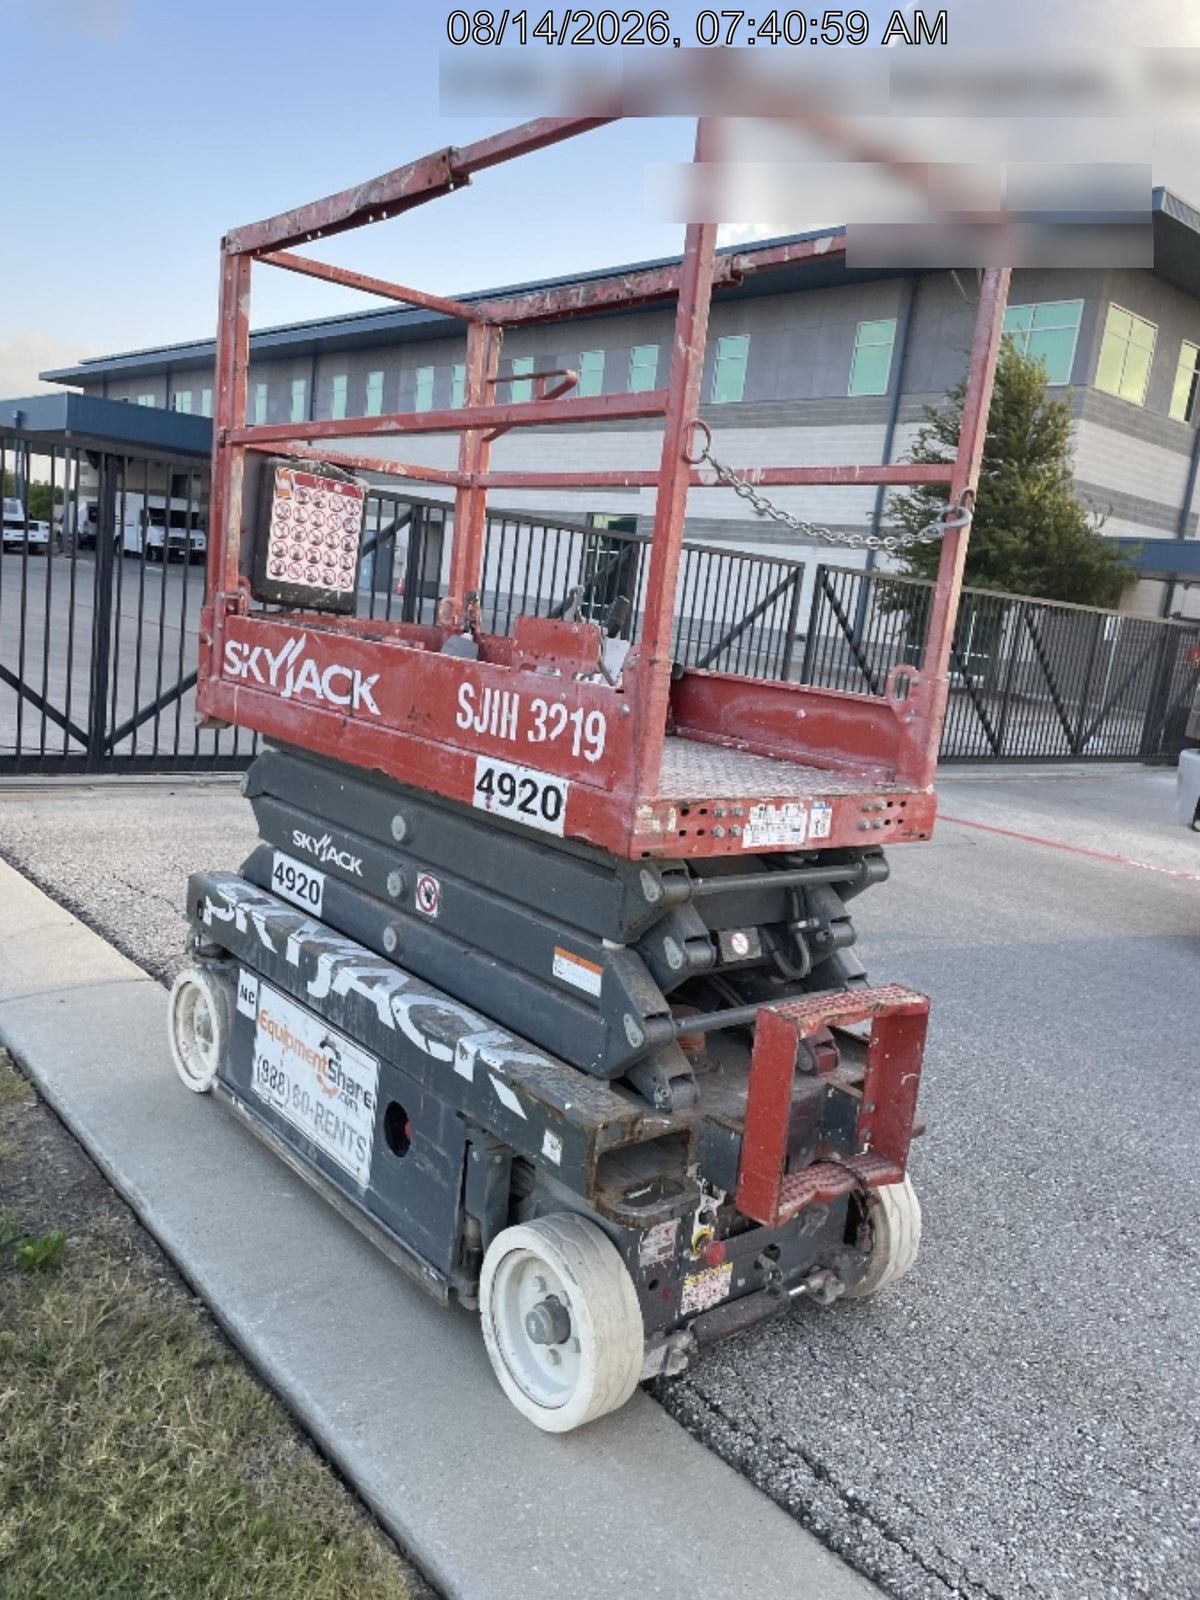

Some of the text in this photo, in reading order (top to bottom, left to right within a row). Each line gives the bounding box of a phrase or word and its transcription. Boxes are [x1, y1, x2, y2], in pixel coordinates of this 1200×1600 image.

[223, 633, 381, 716] SKYJACK
[527, 697, 607, 764] 3219
[475, 766, 563, 822] 4920
[292, 829, 364, 878] SKYJACK
[273, 861, 322, 906] 4920
